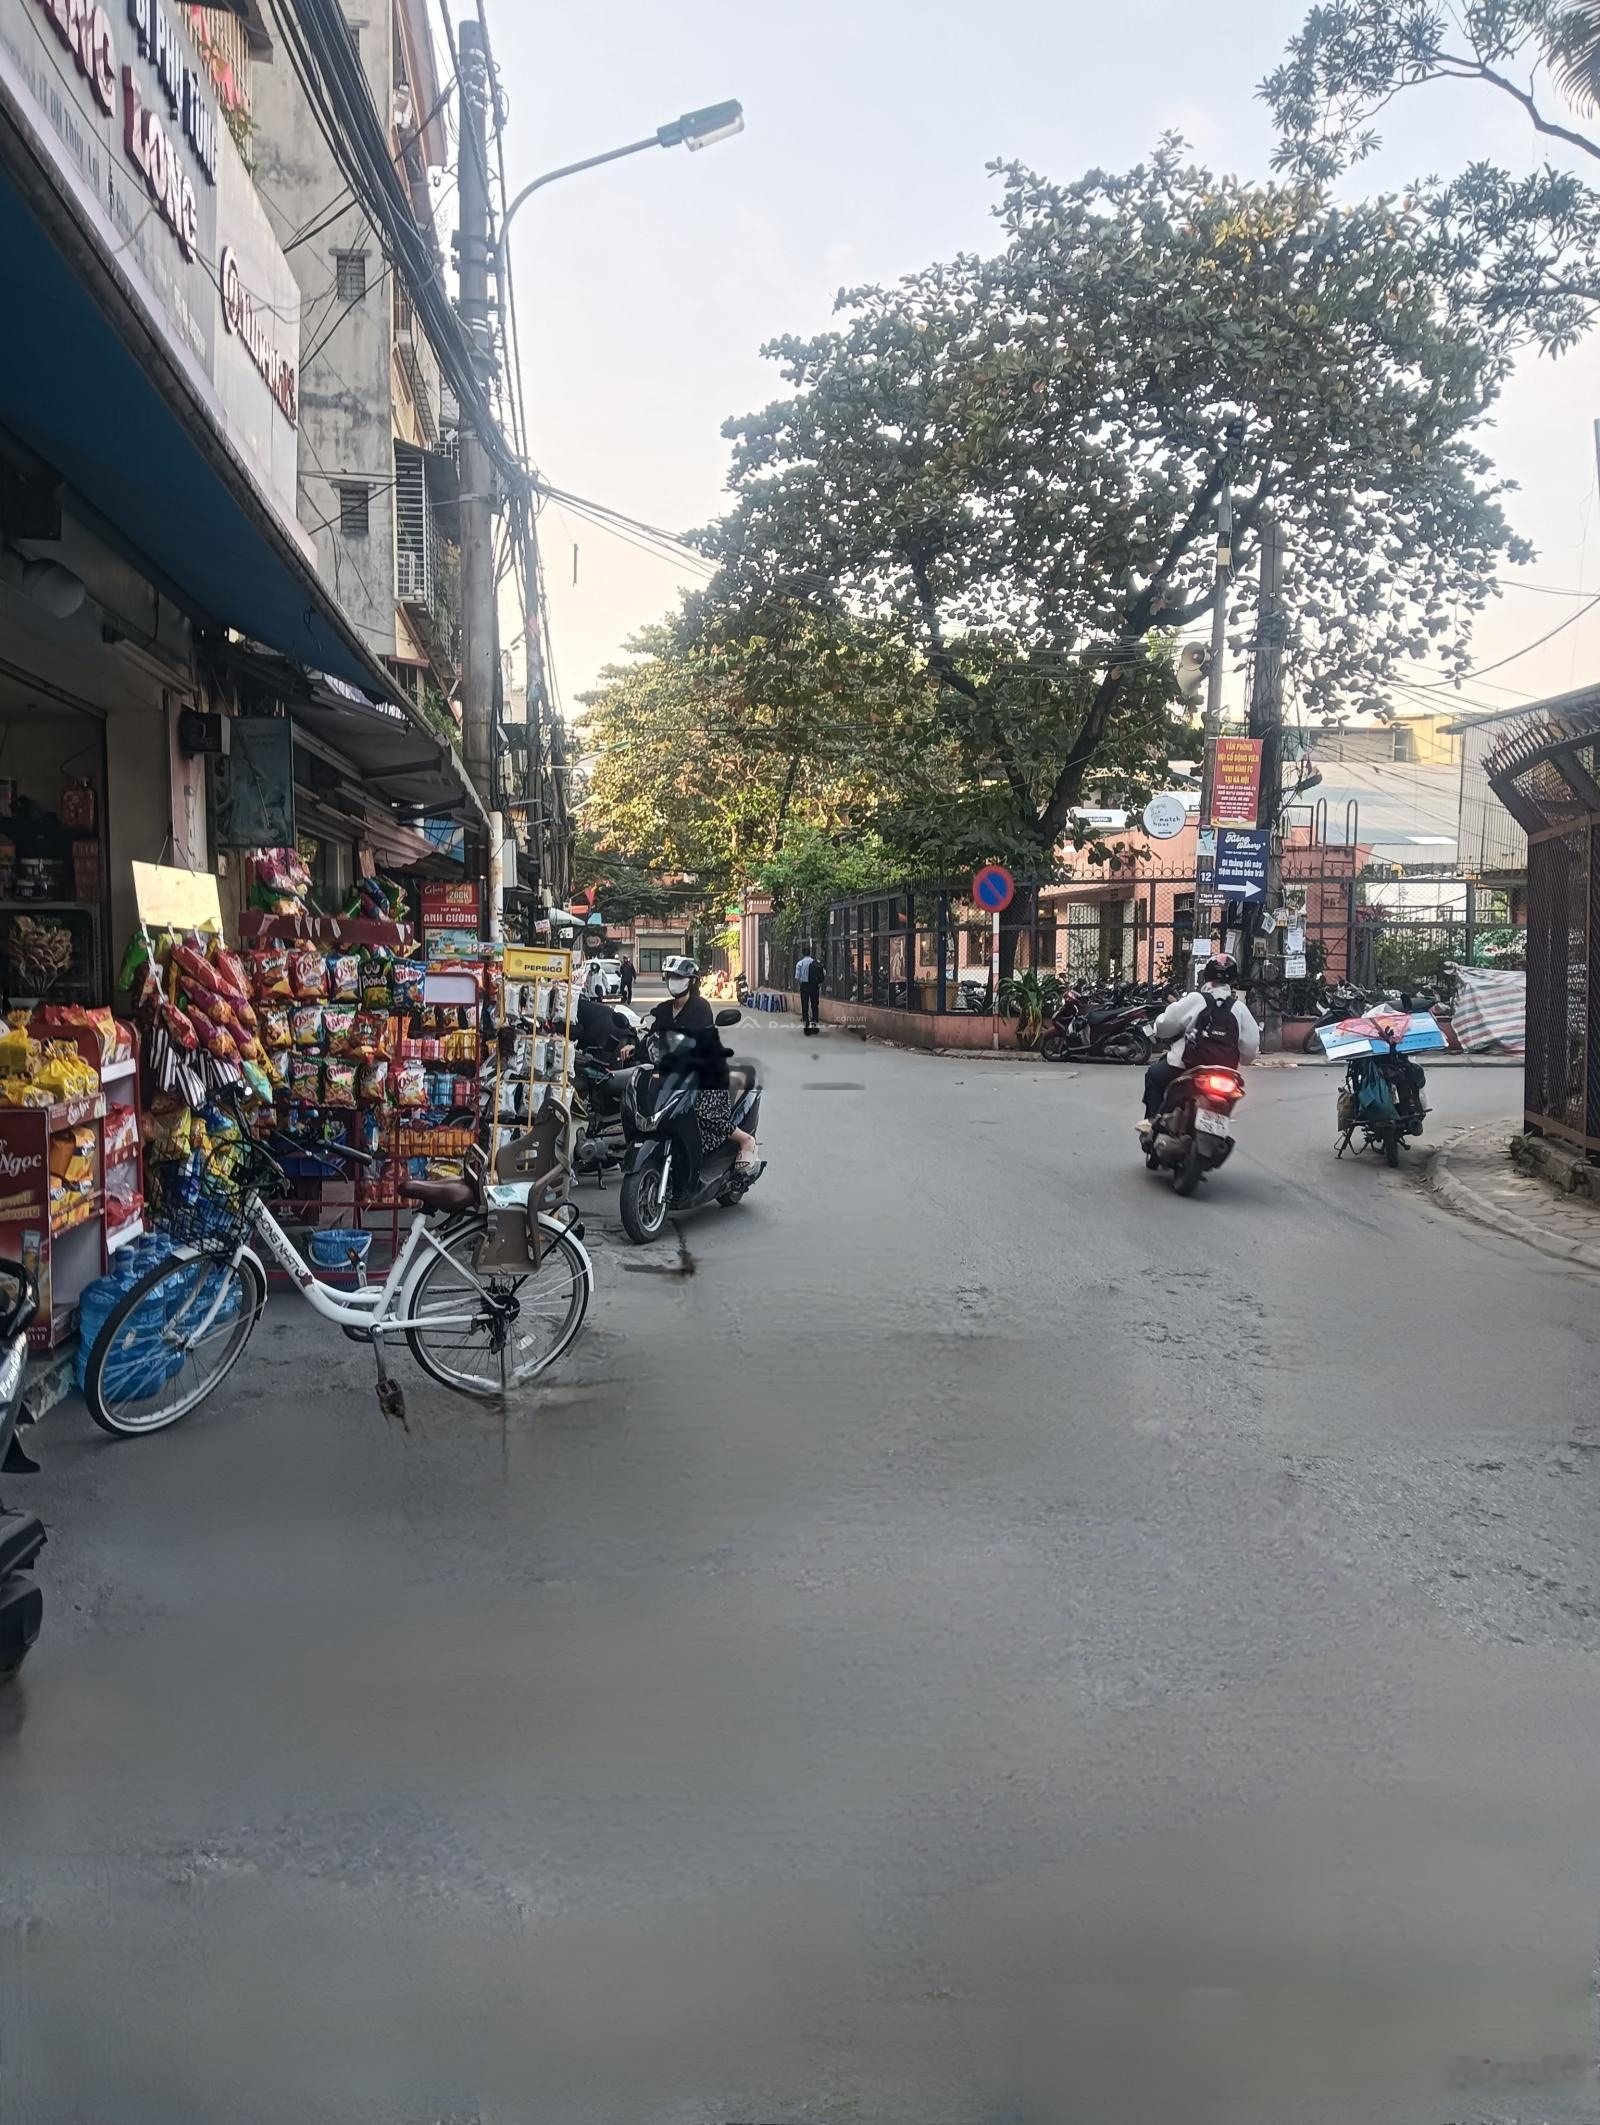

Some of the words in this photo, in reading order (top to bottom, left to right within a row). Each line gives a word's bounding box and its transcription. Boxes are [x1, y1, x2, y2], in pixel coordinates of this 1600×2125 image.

[129, 68, 197, 264] LONG
[1200, 872, 1212, 882] 12
[449, 891, 469, 899] 200K
[424, 913, 443, 922] ANH
[524, 964, 563, 973] PEPSICO
